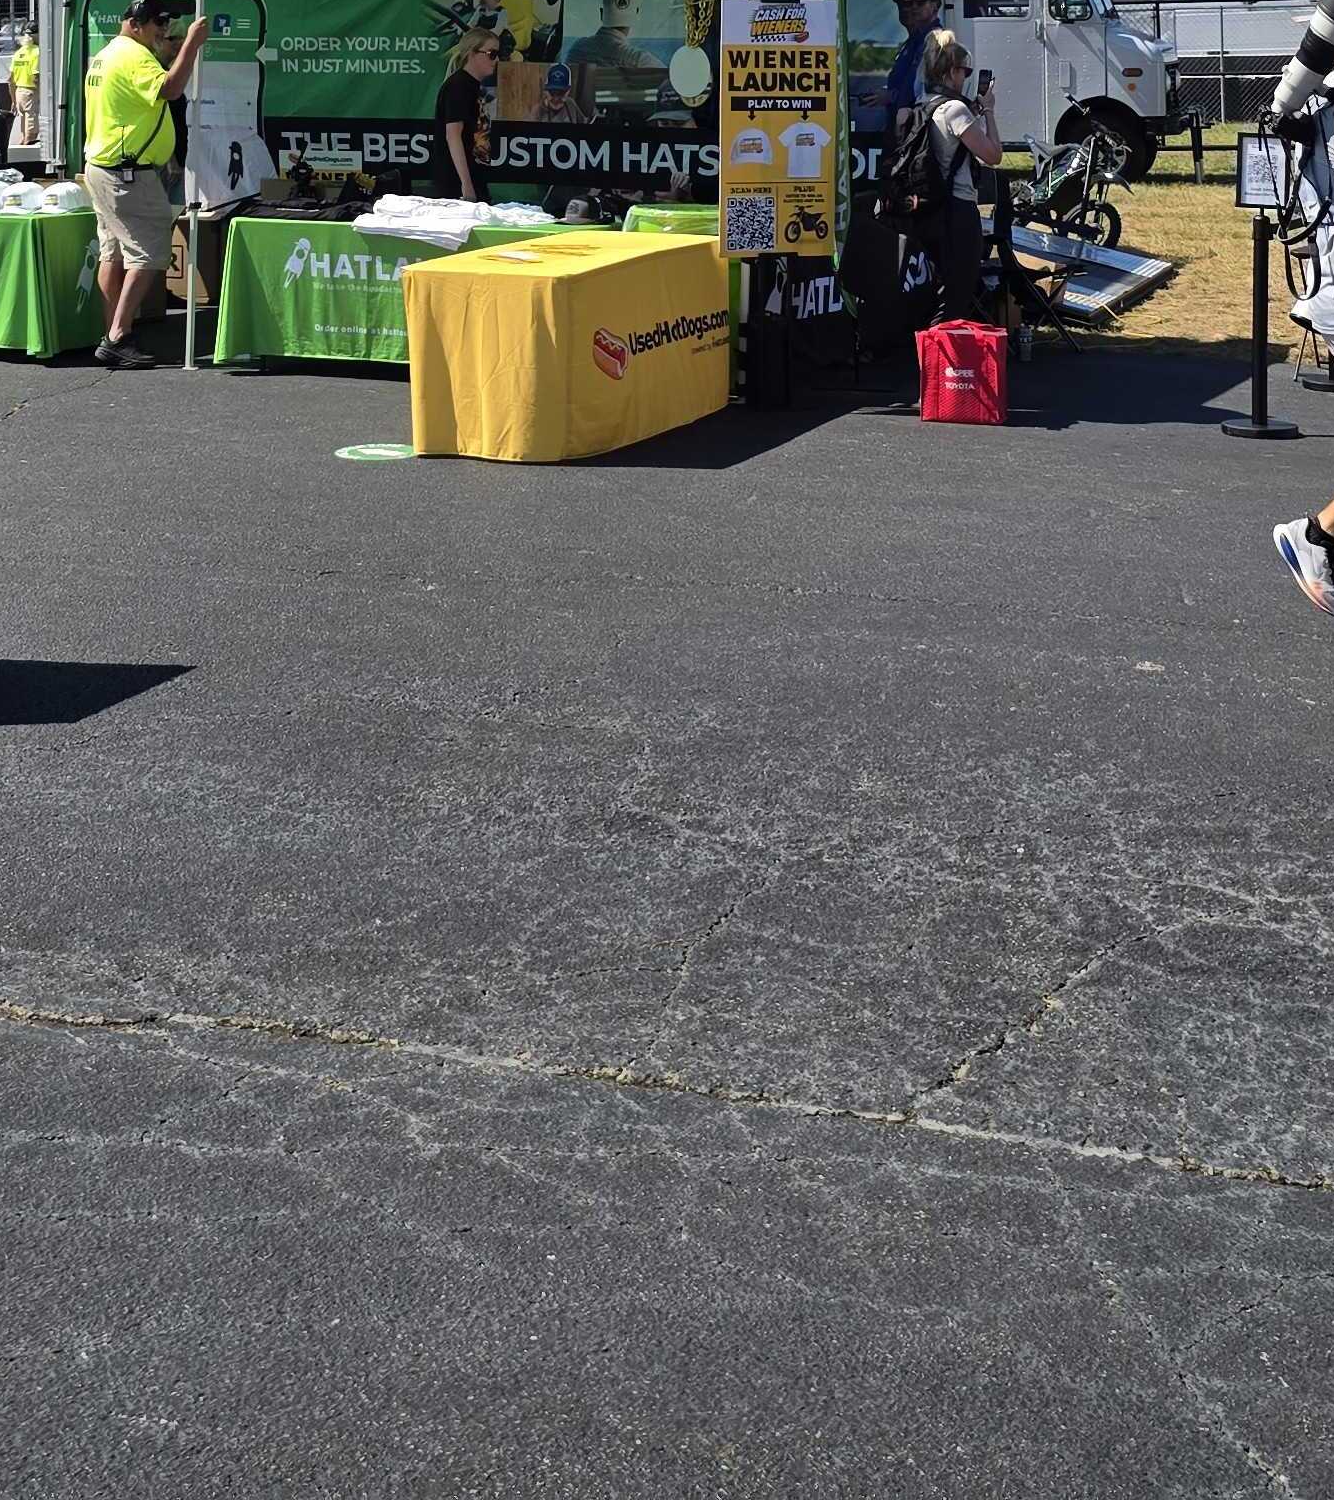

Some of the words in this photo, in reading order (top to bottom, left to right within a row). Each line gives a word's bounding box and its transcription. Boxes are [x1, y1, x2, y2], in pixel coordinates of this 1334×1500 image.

[754, 8, 785, 22] CASH
[786, 7, 806, 20] FOR
[752, 20, 806, 36] WIENERS
[280, 37, 341, 52] ORDER
[345, 37, 391, 52] YOUR
[395, 37, 440, 52] HATS
[282, 58, 299, 73] IN
[302, 58, 345, 74] JUST
[346, 59, 426, 74] MINUTES.
[727, 50, 829, 69] WIENER
[728, 72, 831, 92] LAUNCH
[748, 100, 773, 109] PLAY
[775, 100, 790, 109] TO
[792, 100, 812, 109] WIN
[363, 132, 434, 164] BES
[491, 136, 610, 172] USTOM
[310, 252, 422, 281] HATLA
[315, 324, 338, 333] Order
[341, 325, 367, 334] online
[945, 382, 975, 390] TOYOTA
